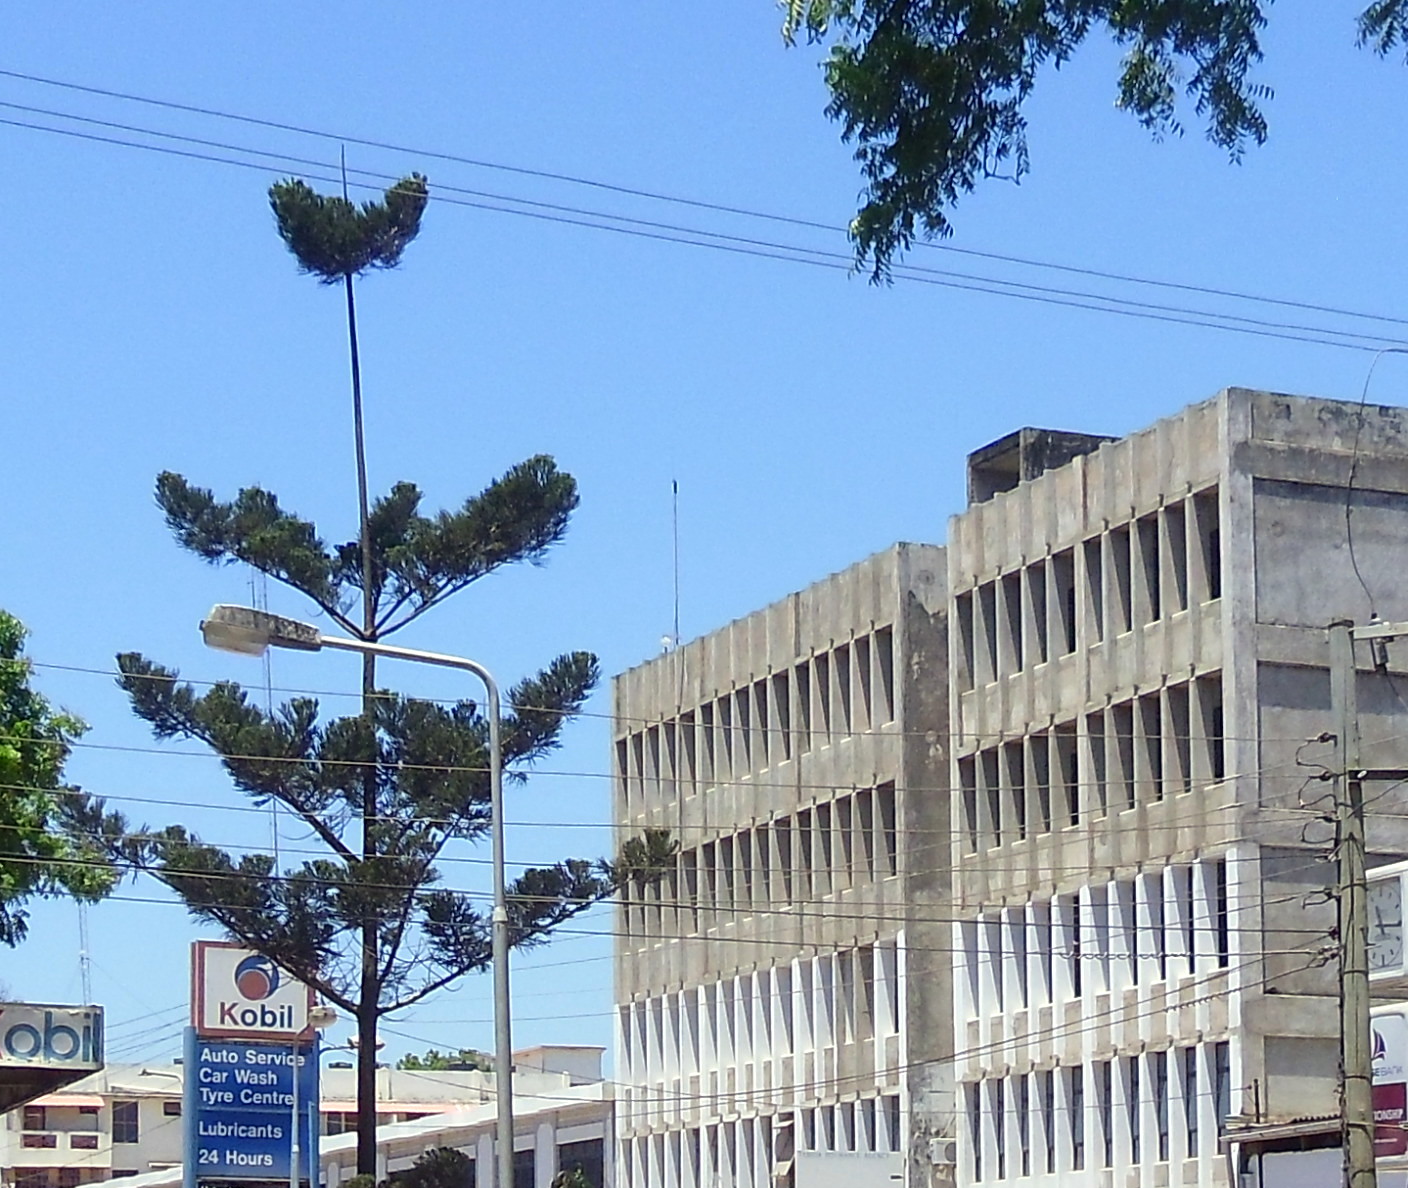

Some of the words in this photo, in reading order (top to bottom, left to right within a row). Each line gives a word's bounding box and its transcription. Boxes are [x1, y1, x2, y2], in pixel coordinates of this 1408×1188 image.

[219, 1002, 292, 1028] Kobil
[201, 1048, 238, 1063] Auto
[245, 1050, 305, 1066] Service
[200, 1068, 229, 1083] Car
[235, 1069, 277, 1085] Wash
[199, 1088, 234, 1104] Tyre
[240, 1089, 294, 1105] Centre
[199, 1121, 282, 1138] Lubricants
[199, 1149, 219, 1164] 24
[226, 1150, 273, 1166] Hours
